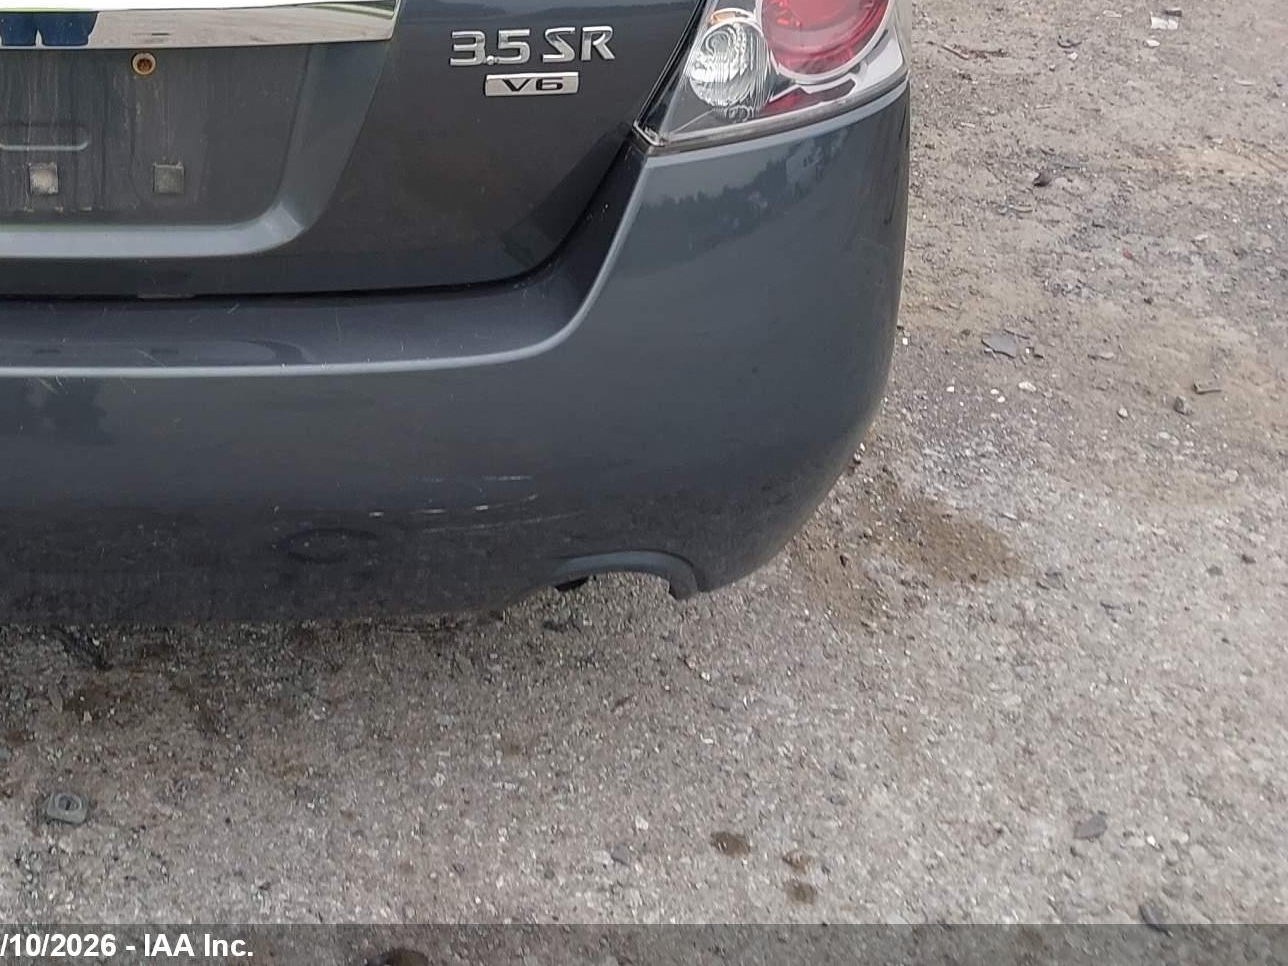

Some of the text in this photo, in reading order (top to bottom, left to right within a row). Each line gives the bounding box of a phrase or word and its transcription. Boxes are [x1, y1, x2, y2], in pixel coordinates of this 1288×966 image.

[449, 25, 616, 66] 3.5 SR
[502, 77, 564, 92] V6
